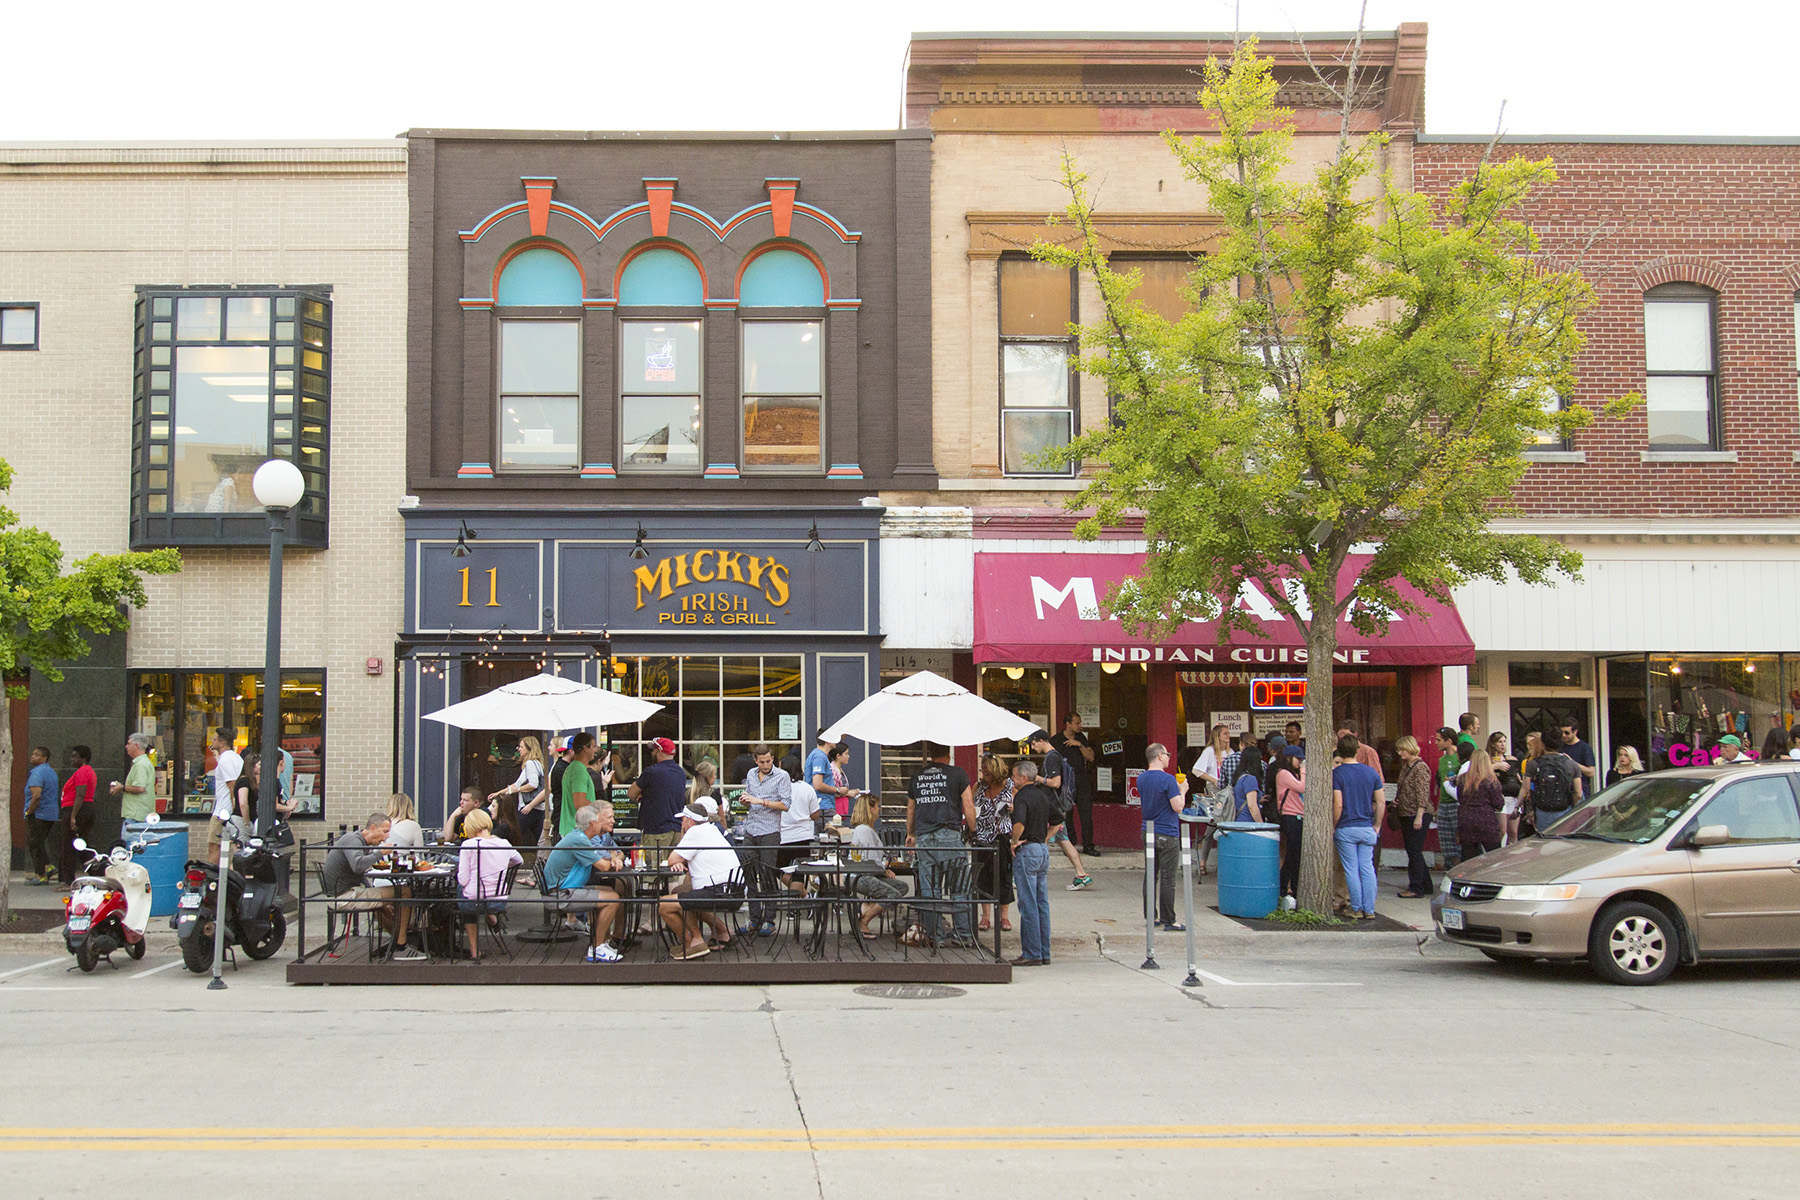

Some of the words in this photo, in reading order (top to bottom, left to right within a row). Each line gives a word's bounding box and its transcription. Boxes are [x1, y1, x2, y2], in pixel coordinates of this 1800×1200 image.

[645, 368, 676, 381] OPEN
[632, 549, 790, 612] MICKY'S
[457, 566, 502, 607] 11
[680, 592, 748, 612] IRISH
[658, 612, 698, 625] PUB
[702, 612, 716, 625] &
[720, 612, 776, 625] GRILL
[1092, 647, 1214, 662] INDIAN
[1230, 648, 1370, 664] CUISNE
[1217, 713, 1242, 721] Lunch
[1103, 743, 1122, 753] OPEN
[917, 773, 948, 781] World's
[916, 781, 947, 789] Largest
[920, 788, 942, 796] Grill.
[916, 796, 948, 804] PERIOD.
